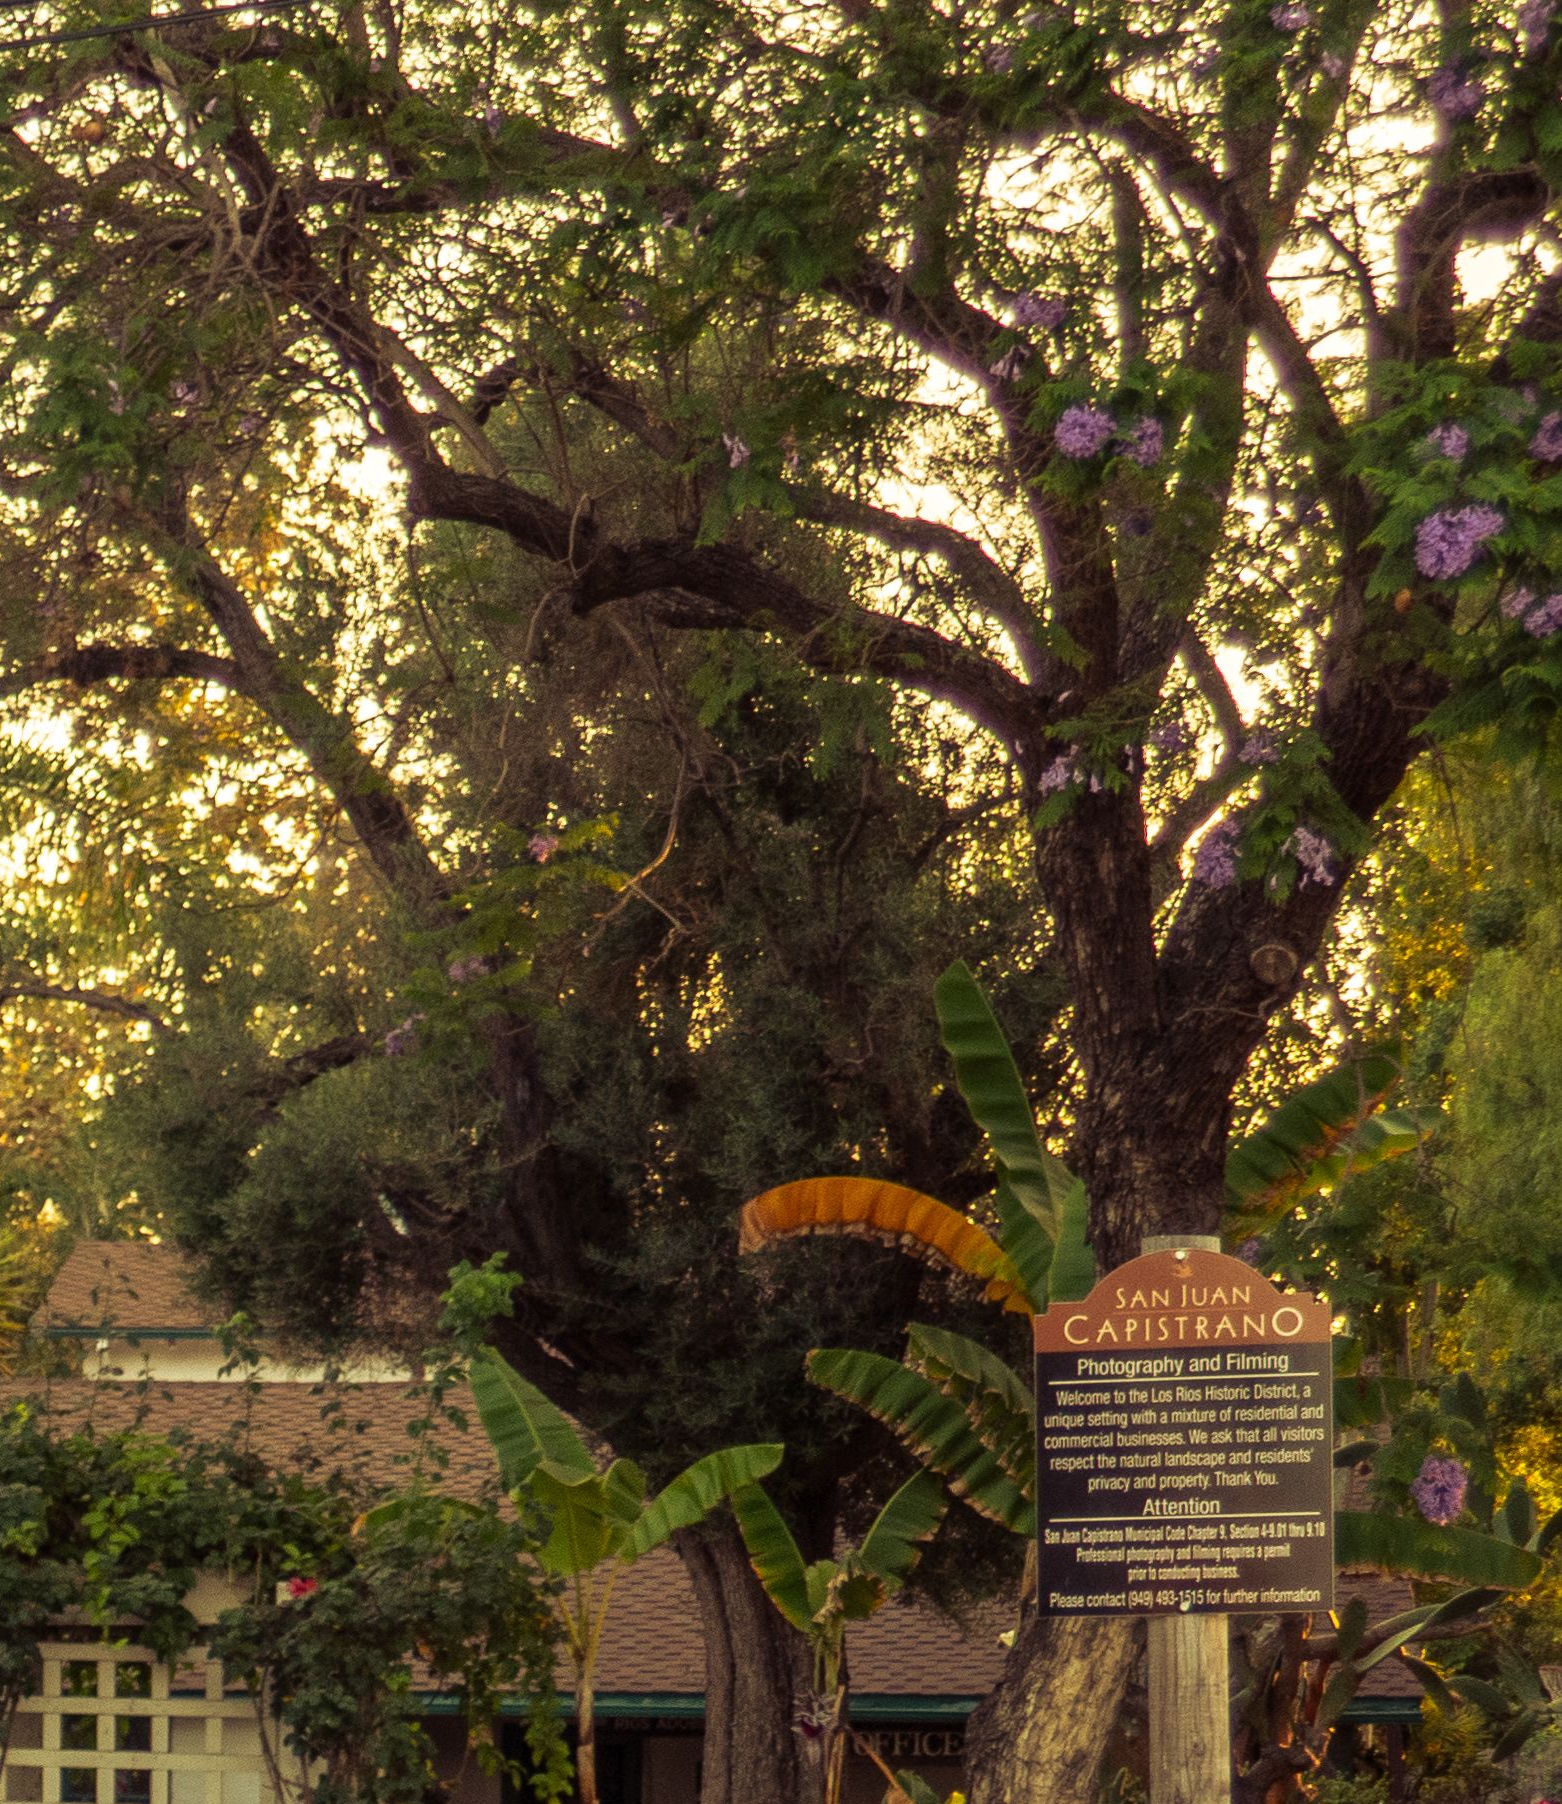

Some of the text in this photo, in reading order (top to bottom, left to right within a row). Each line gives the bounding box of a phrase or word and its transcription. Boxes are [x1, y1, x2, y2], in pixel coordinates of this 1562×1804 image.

[1116, 1284, 1251, 1309] SAN JUAN
[1063, 1307, 1303, 1344] CAPISTRANO
[1077, 1352, 1289, 1376] Photography and Filming
[1056, 1390, 1110, 1406] Welcome
[1114, 1390, 1125, 1404] to
[1129, 1389, 1147, 1404] the
[1151, 1388, 1172, 1403] Los
[1176, 1388, 1201, 1402] Rios
[1205, 1385, 1250, 1400] Historic
[1303, 1386, 1311, 1398] a
[1045, 1404, 1324, 1430] unique setting with a mixture of residential and
[1044, 1432, 1114, 1450] commercial
[1189, 1430, 1207, 1444] We
[1211, 1428, 1233, 1443] ask
[1236, 1427, 1259, 1442] that
[1263, 1427, 1277, 1442] all
[1281, 1426, 1324, 1441] visitors
[1050, 1454, 1094, 1472] respect
[1098, 1454, 1116, 1469] the
[1120, 1452, 1161, 1468] natural
[1165, 1450, 1226, 1468] landscape
[1229, 1450, 1251, 1465] and
[1088, 1476, 1130, 1493] privacy
[1134, 1474, 1156, 1489] and
[1215, 1470, 1251, 1487] Thank
[1143, 1498, 1220, 1516] Attention
[1049, 1592, 1084, 1608] Please
[1087, 1592, 1125, 1608] contact
[1128, 1590, 1153, 1608] (949)
[1207, 1589, 1220, 1604] for
[1223, 1588, 1257, 1603] further
[1260, 1587, 1320, 1603] information
[853, 1731, 963, 1757] OFFICE
